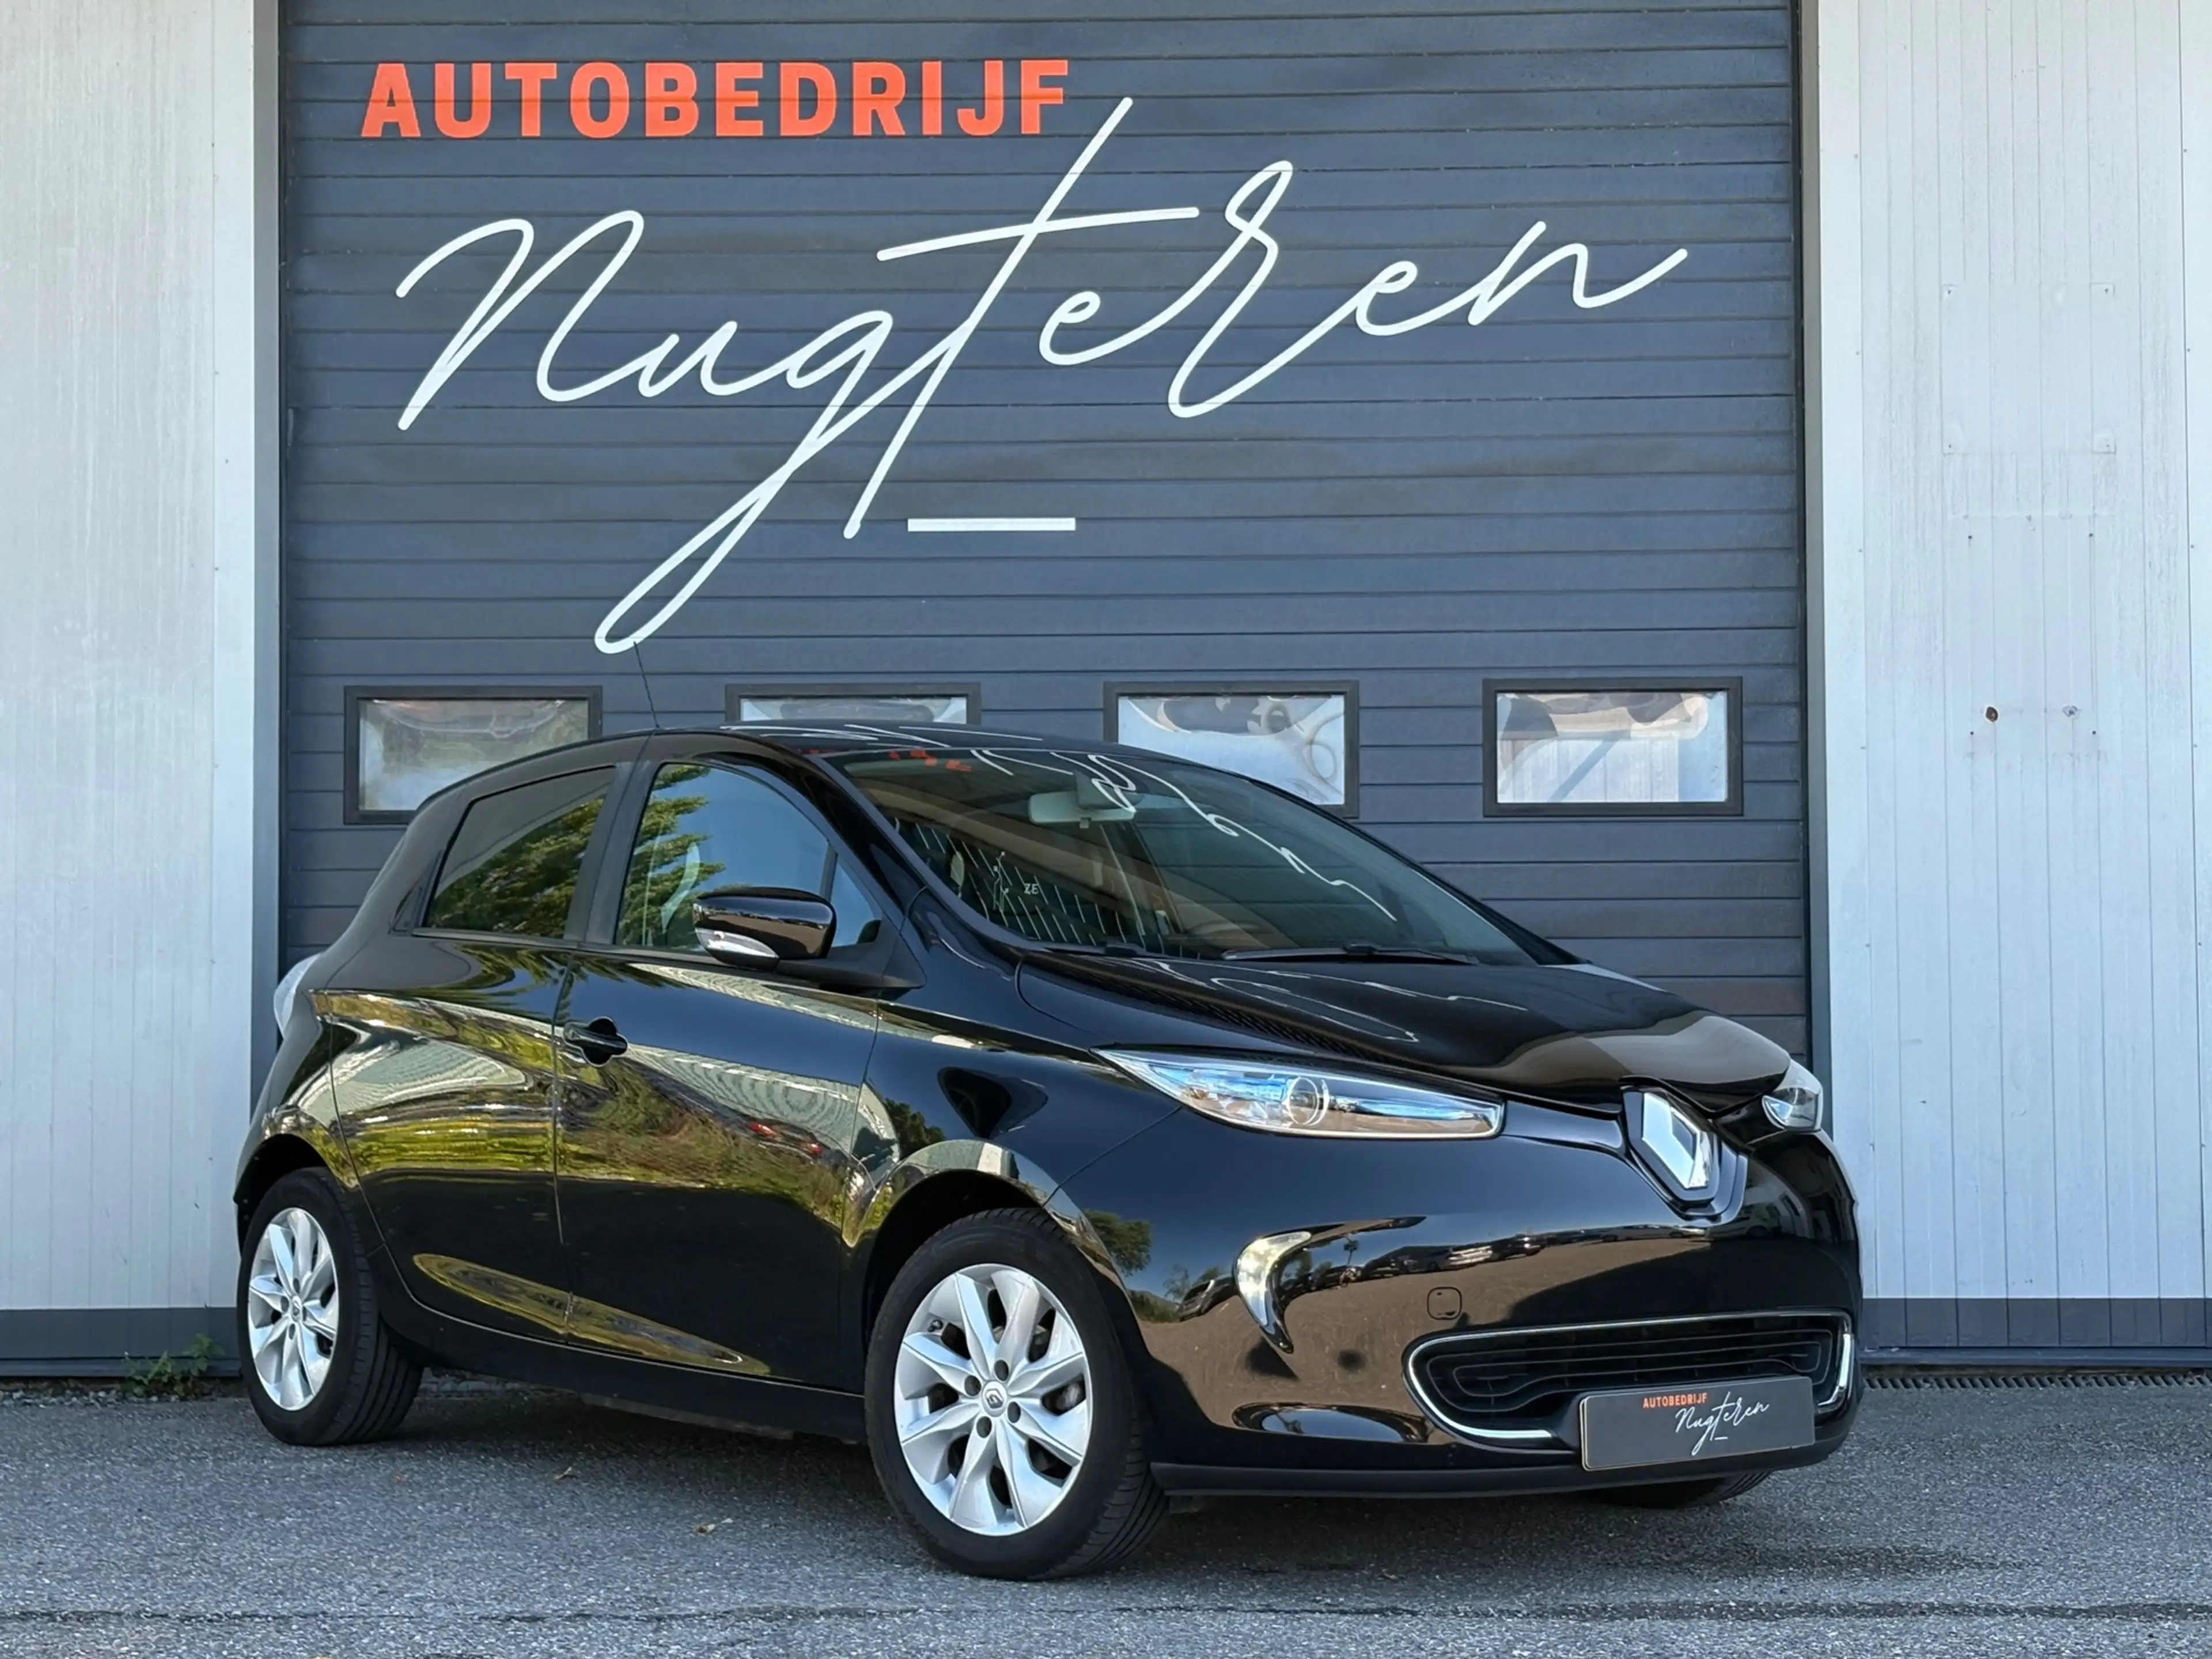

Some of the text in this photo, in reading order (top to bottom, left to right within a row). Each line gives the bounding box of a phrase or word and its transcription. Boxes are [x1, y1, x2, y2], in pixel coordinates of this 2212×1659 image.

[361, 59, 1069, 138] AUTOBEDRIJF
[396, 97, 1688, 653] Nugteren
[1642, 1393, 1708, 1408] AUTOBEDRIJF
[1675, 1391, 1770, 1456] Nugteren
